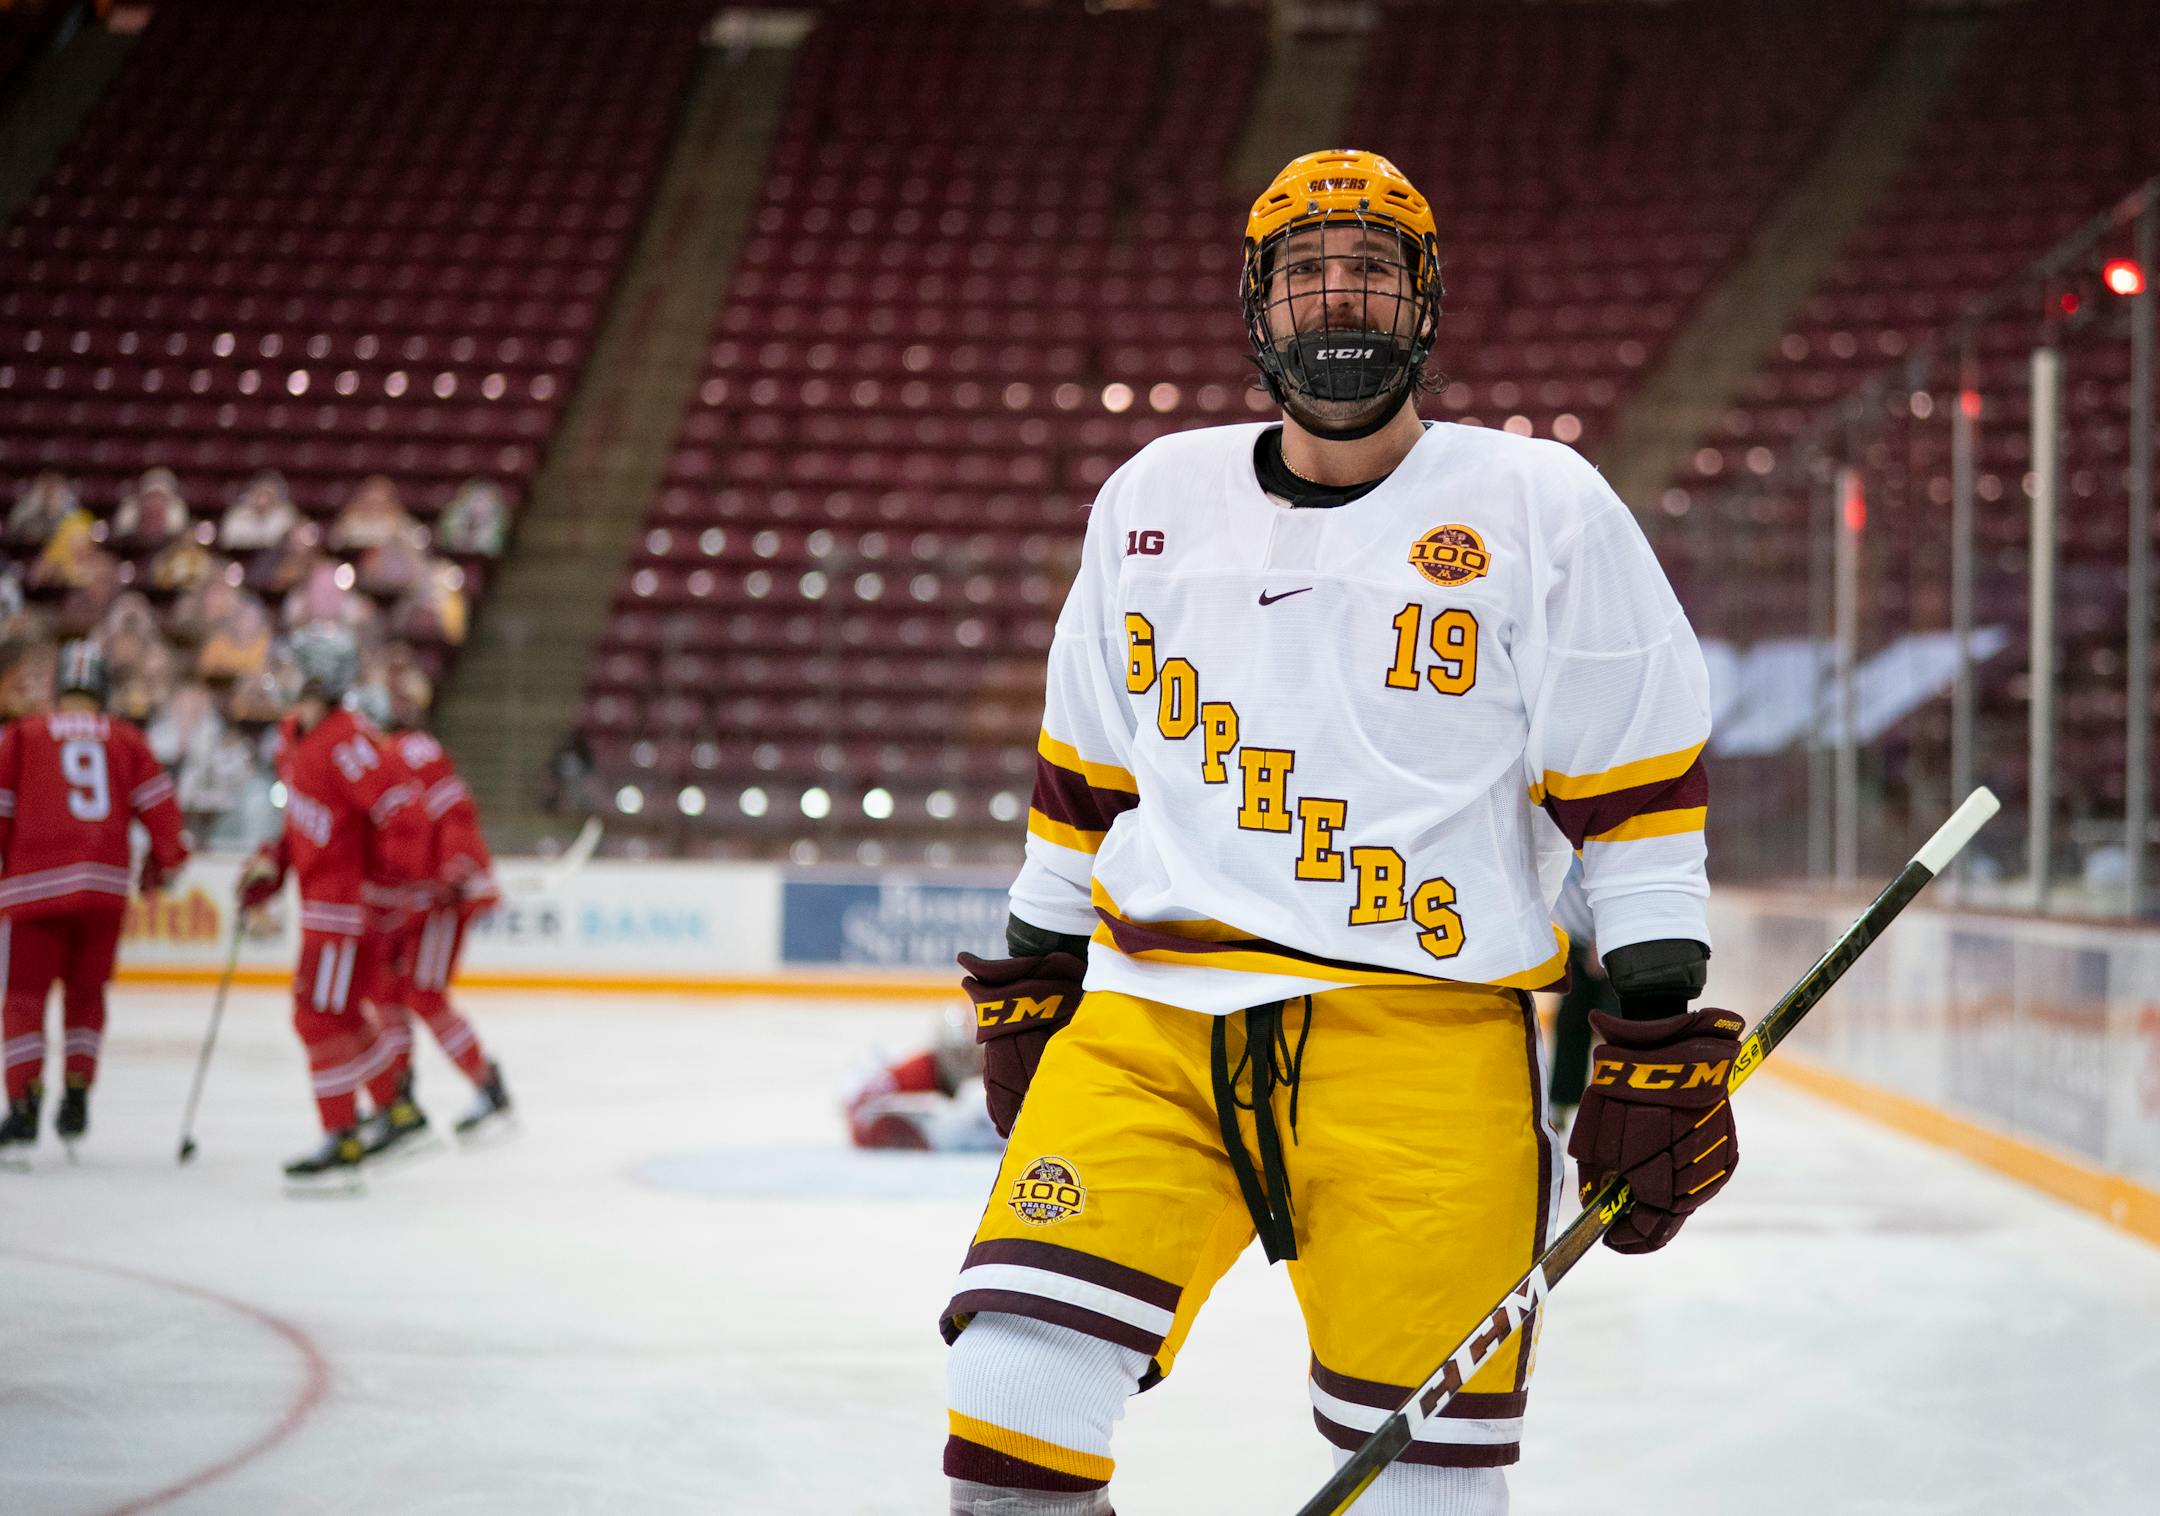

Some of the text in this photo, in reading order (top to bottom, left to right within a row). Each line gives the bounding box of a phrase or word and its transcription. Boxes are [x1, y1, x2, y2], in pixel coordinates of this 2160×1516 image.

[1310, 177, 1367, 192] GOPHERS
[1316, 348, 1374, 360] CCM
[1412, 544, 1486, 570] 100
[1385, 603, 1479, 696] 19
[61, 740, 110, 820] 9
[1124, 612, 1466, 960] GOPHERS
[1592, 1058, 1730, 1090] CCM
[1013, 1182, 1081, 1207] 100
[1397, 1262, 1549, 1440] CCM
